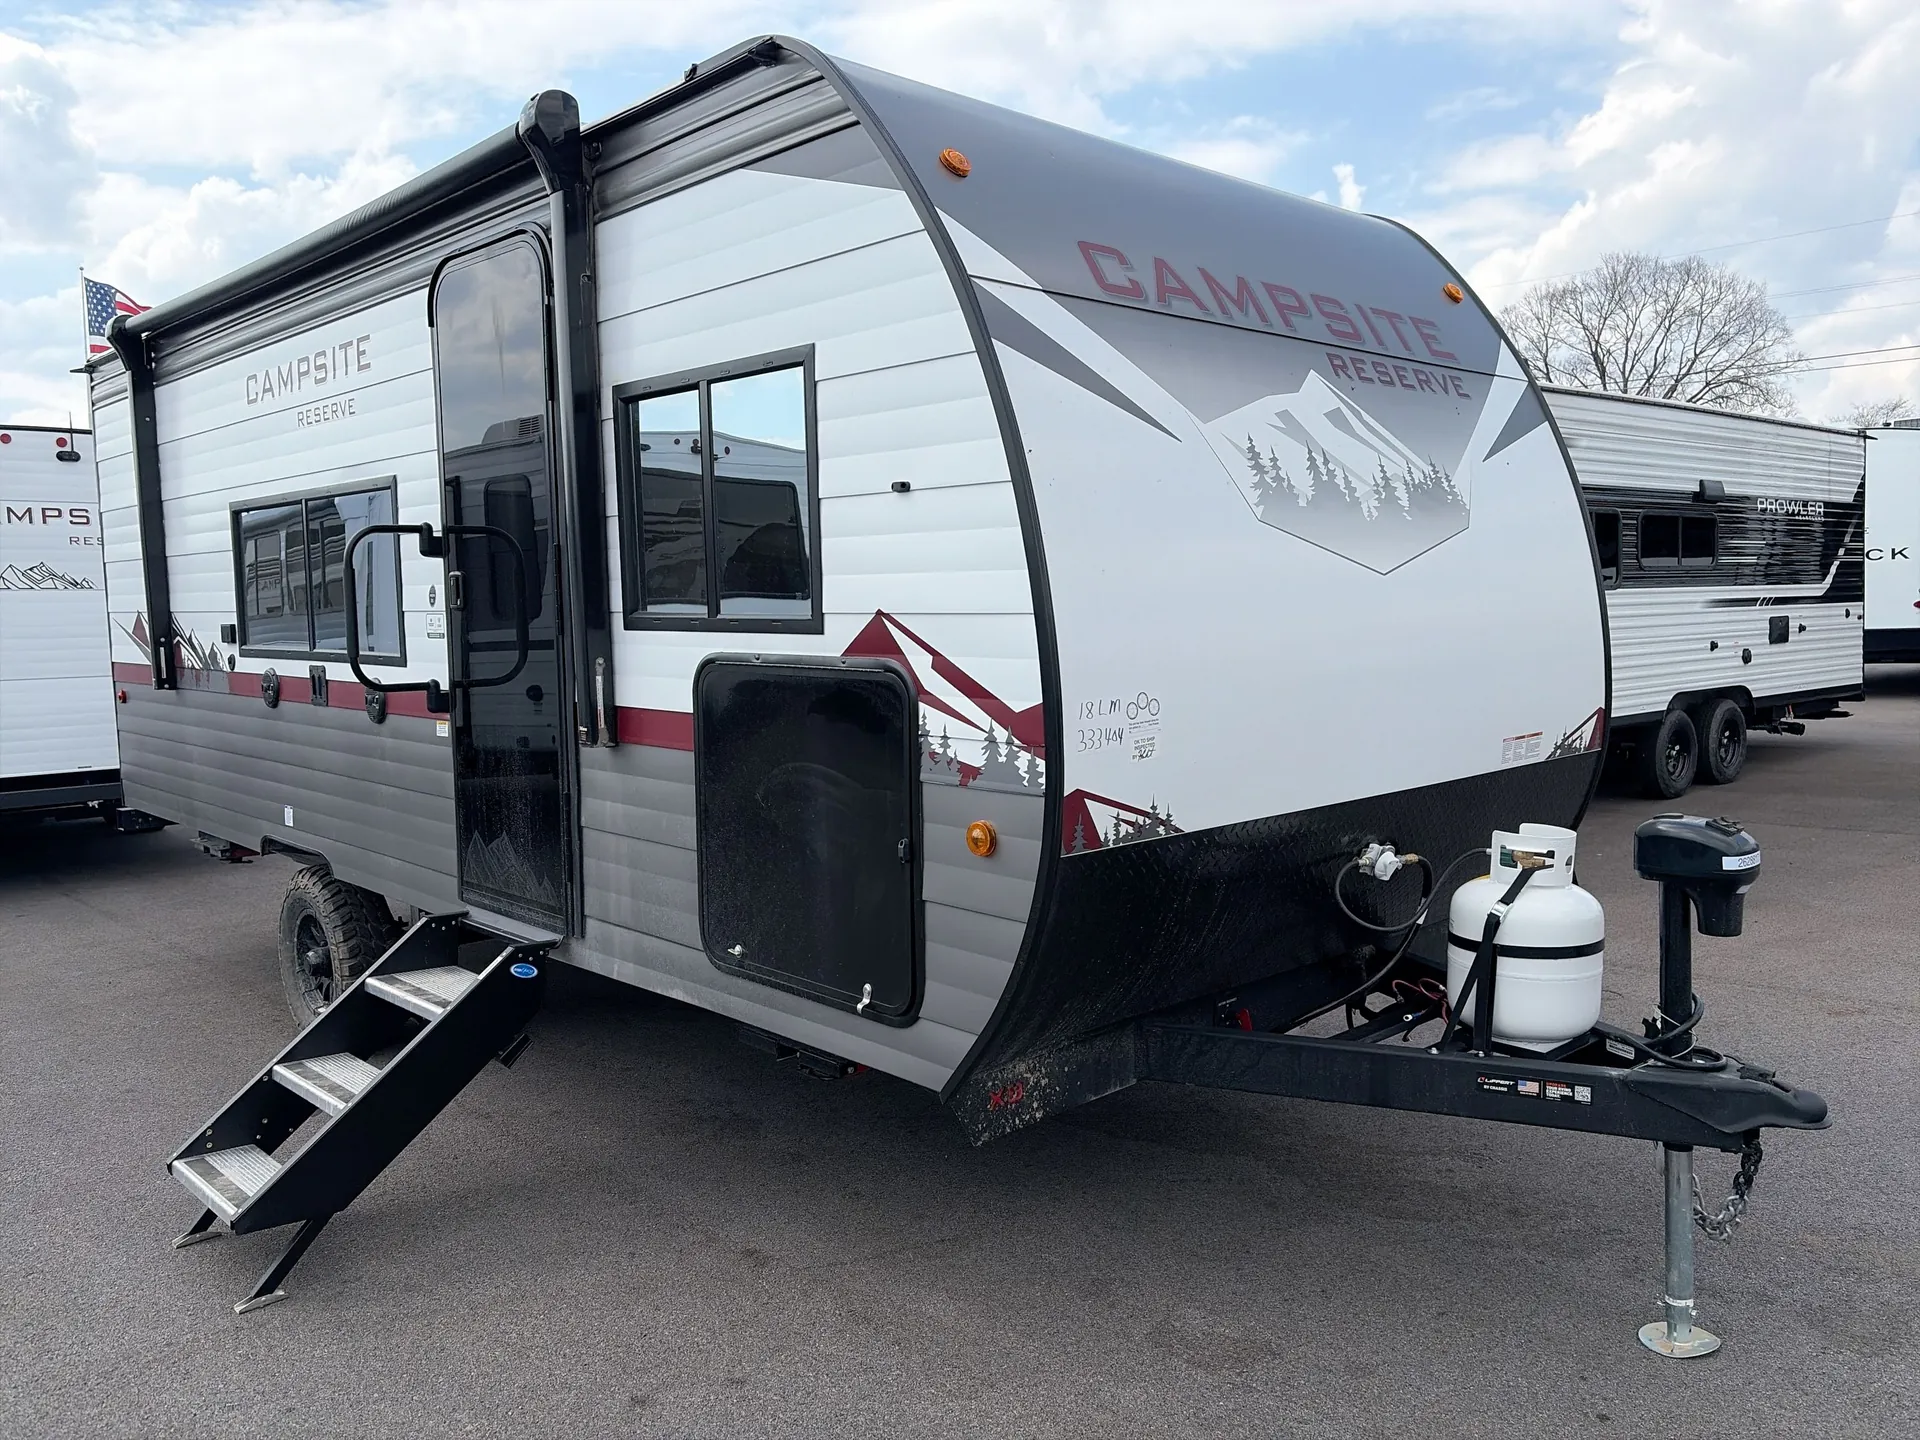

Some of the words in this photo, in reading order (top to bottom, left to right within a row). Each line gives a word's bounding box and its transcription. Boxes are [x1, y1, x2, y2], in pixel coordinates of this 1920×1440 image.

[1077, 241, 1461, 364] CAMPSITE
[246, 334, 371, 406] CAMPSITE
[1325, 352, 1472, 400] RESERVE
[297, 398, 356, 428] RESERVE
[0, 506, 92, 526] MPS
[1757, 498, 1825, 516] PROWLER
